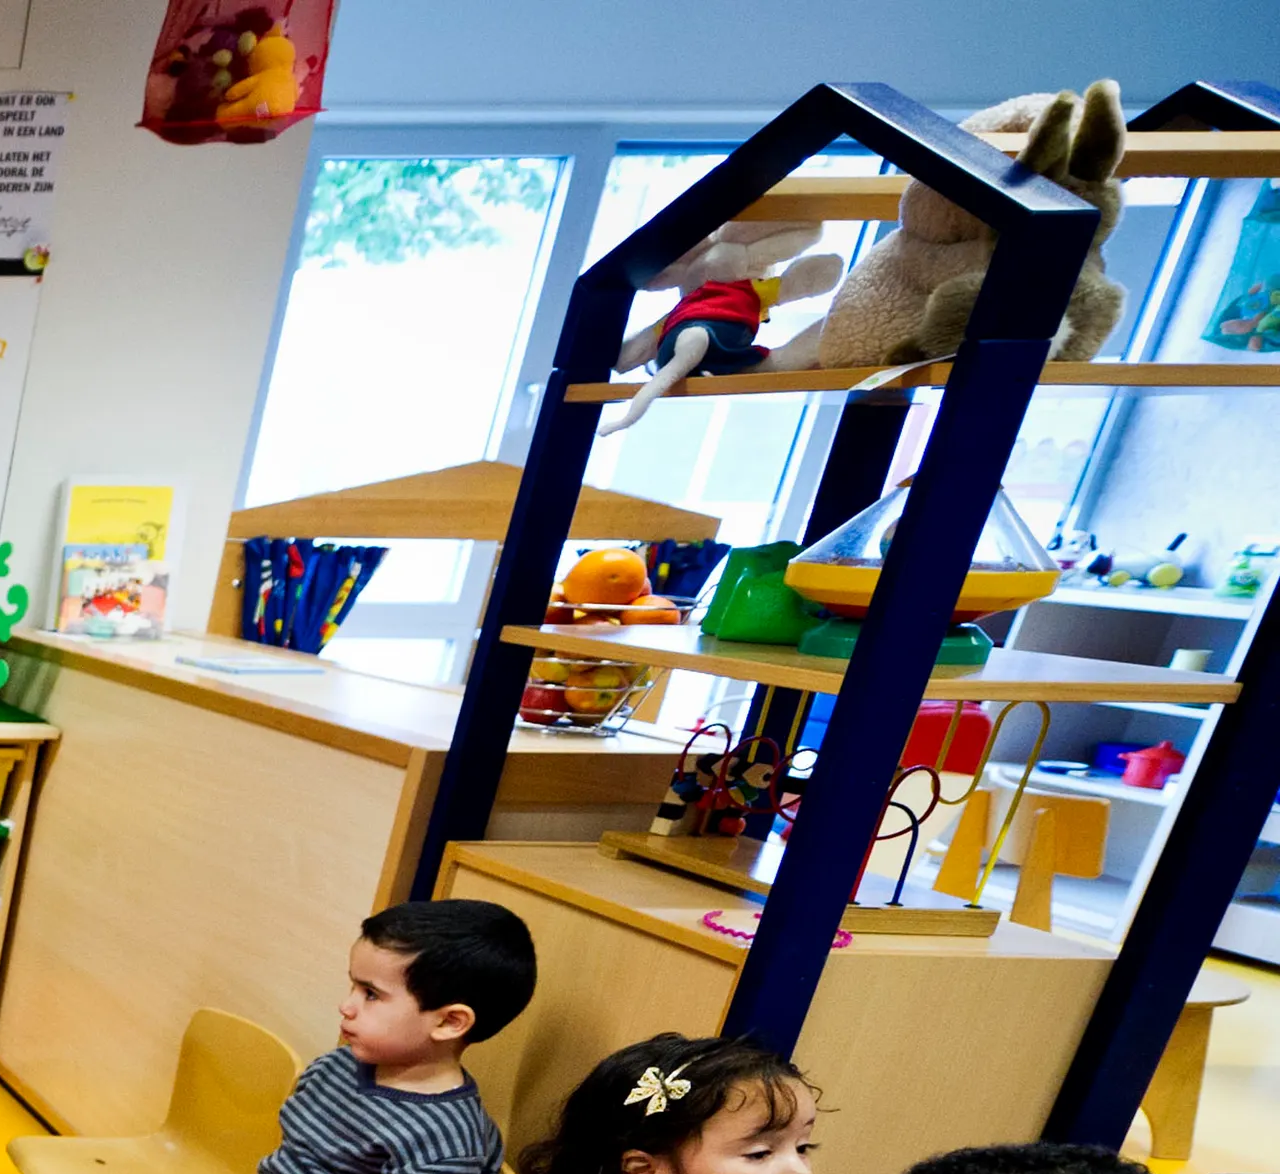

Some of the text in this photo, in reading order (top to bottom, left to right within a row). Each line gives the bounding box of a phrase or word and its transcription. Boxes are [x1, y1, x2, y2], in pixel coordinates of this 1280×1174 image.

[19, 95, 33, 106] ER
[3, 125, 65, 137] IN EEN LAND
[31, 151, 51, 162] HET
[31, 167, 45, 177] DE
[33, 182, 54, 192] ZIJN
